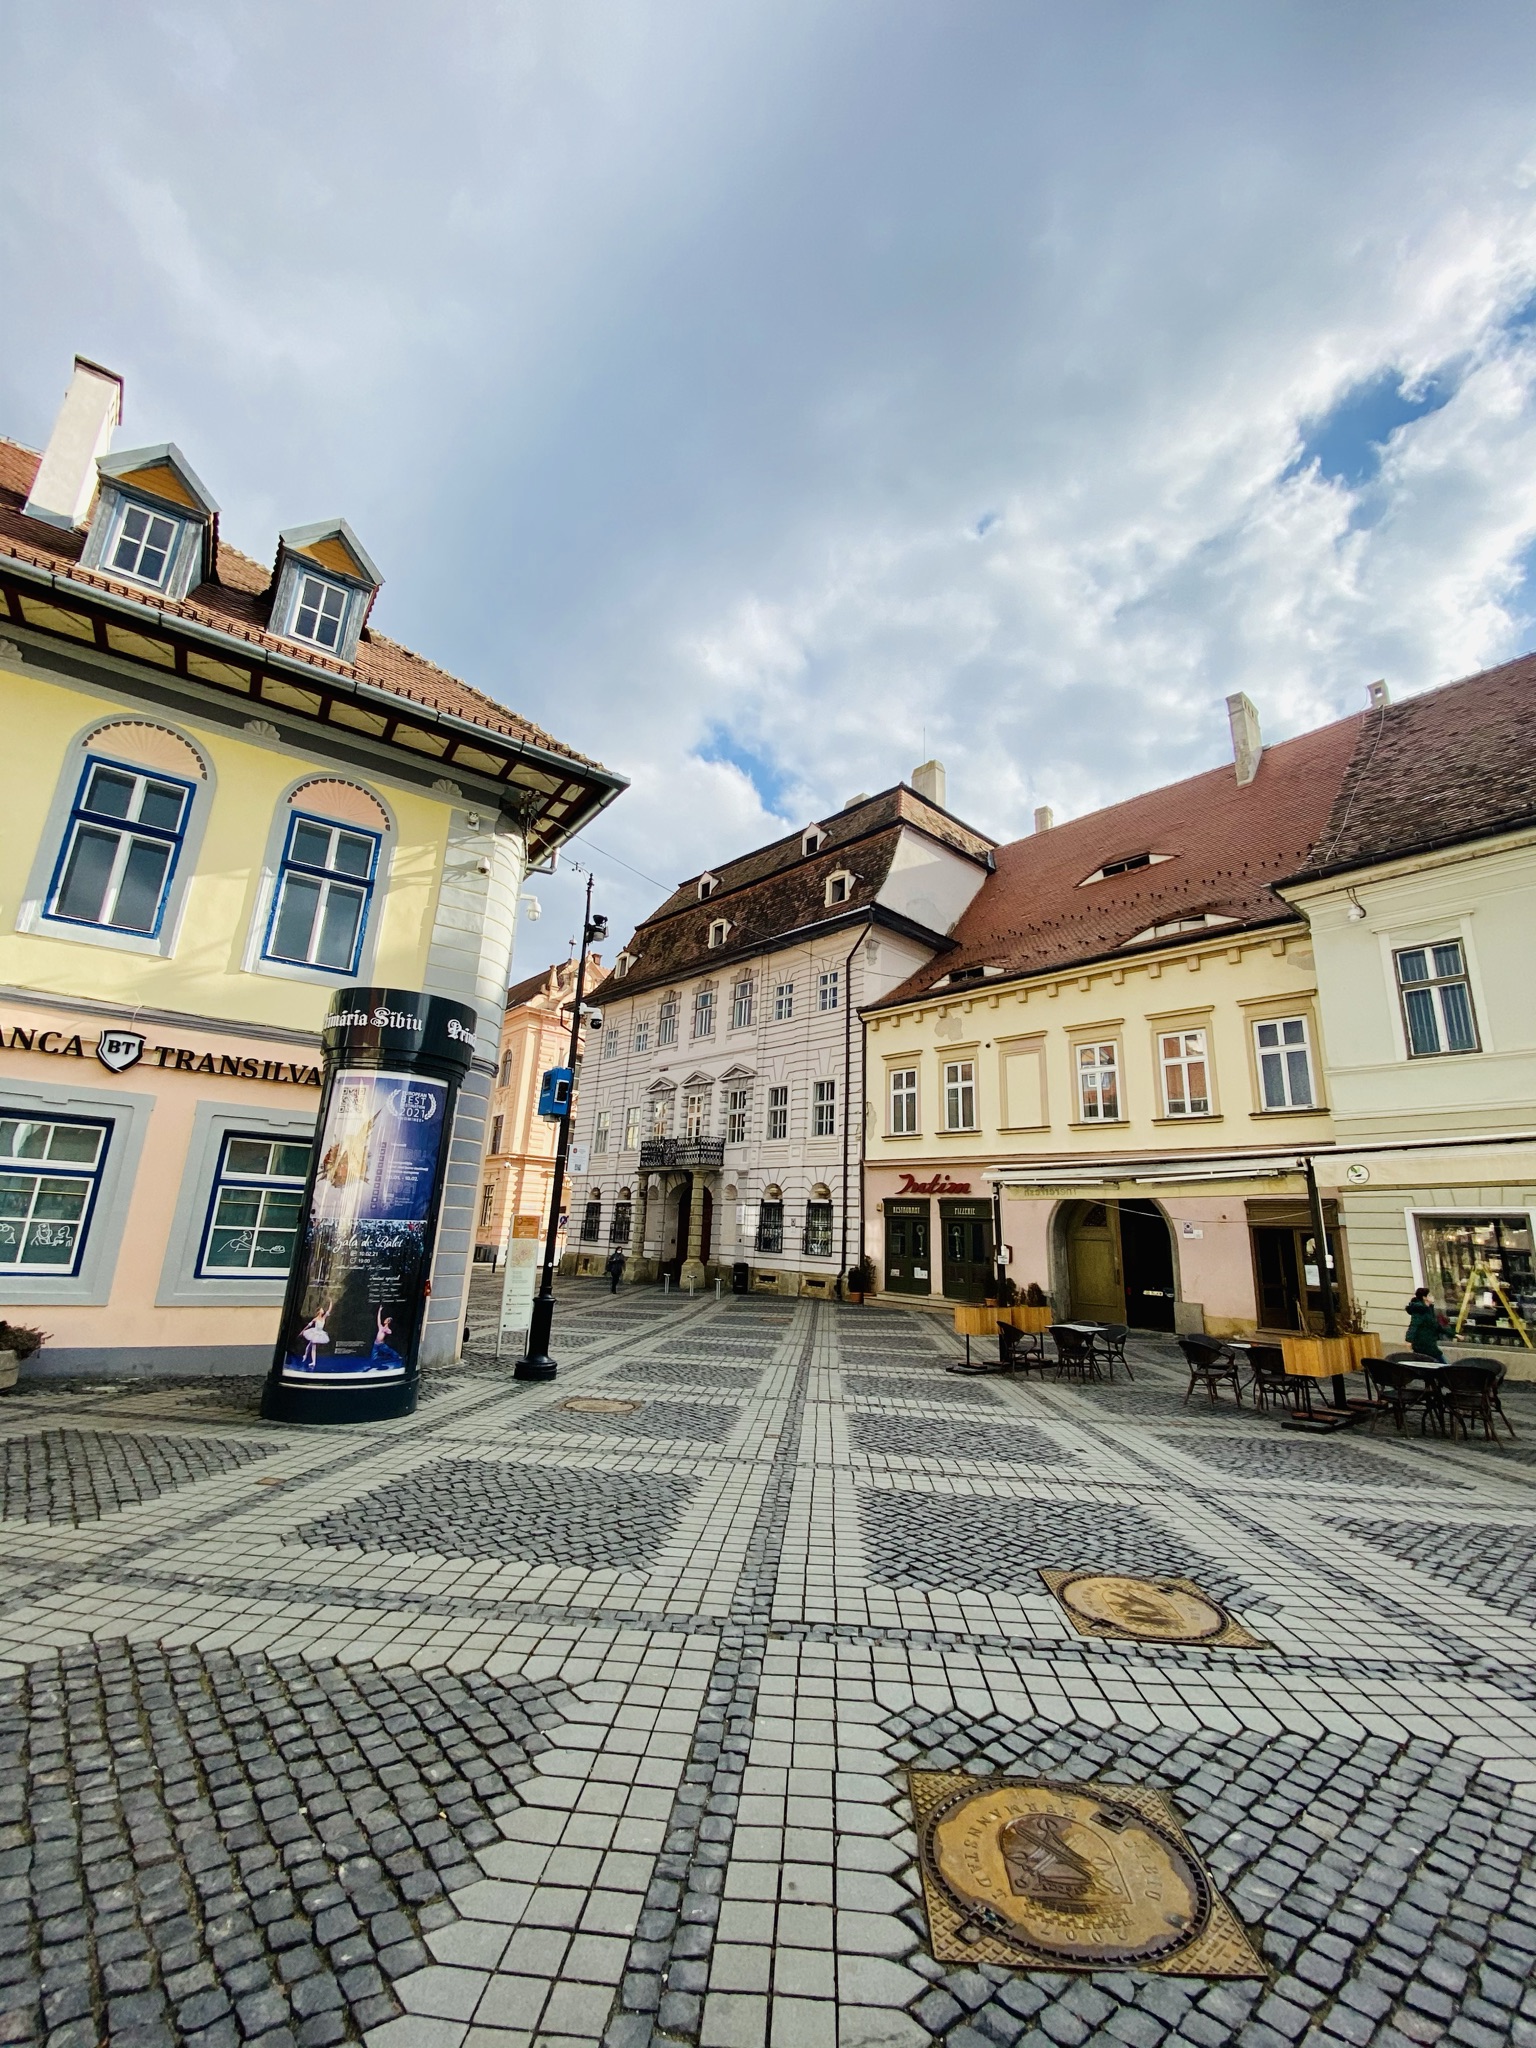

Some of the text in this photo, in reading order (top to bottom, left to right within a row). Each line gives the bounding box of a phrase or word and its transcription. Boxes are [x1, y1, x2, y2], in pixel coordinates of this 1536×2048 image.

[370, 1007, 422, 1031] Sibiu
[107, 1040, 136, 1055] BT
[155, 1045, 322, 1086] TRANSILVA
[401, 1095, 426, 1106] BEST
[399, 1108, 425, 1118] 2021
